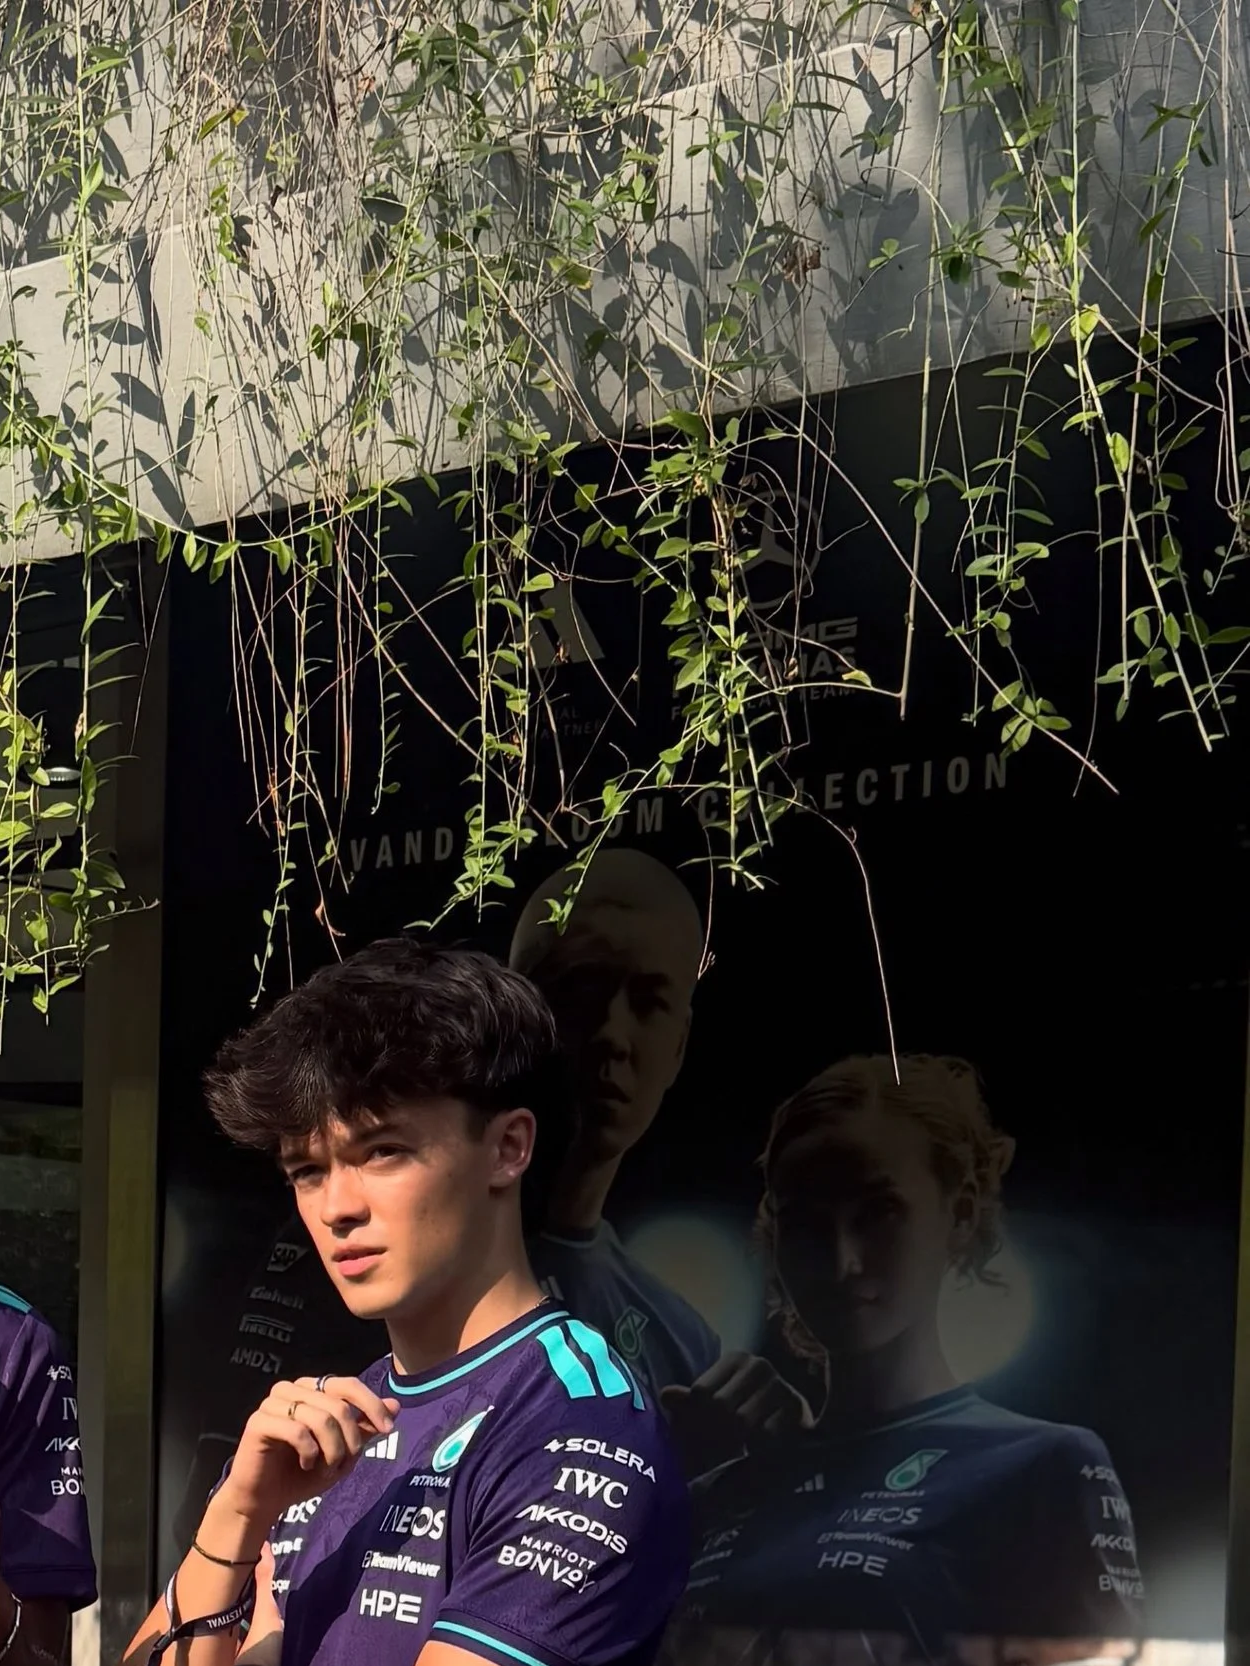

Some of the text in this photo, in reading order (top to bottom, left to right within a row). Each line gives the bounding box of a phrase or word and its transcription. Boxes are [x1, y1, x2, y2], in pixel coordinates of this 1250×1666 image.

[350, 821, 483, 872] VAND
[697, 752, 1008, 828] CLECTION
[230, 1347, 265, 1369] AMD
[564, 1438, 657, 1483] SOLERA
[553, 1467, 629, 1509] IWC
[379, 1504, 447, 1540] INEOS
[836, 1507, 923, 1526] INEOS
[370, 1552, 441, 1578] TeamViewer
[497, 1545, 595, 1594] BONVOY
[520, 1535, 597, 1570] MARRIOTT
[817, 1550, 889, 1577] HPE
[359, 1588, 422, 1625] HPE
